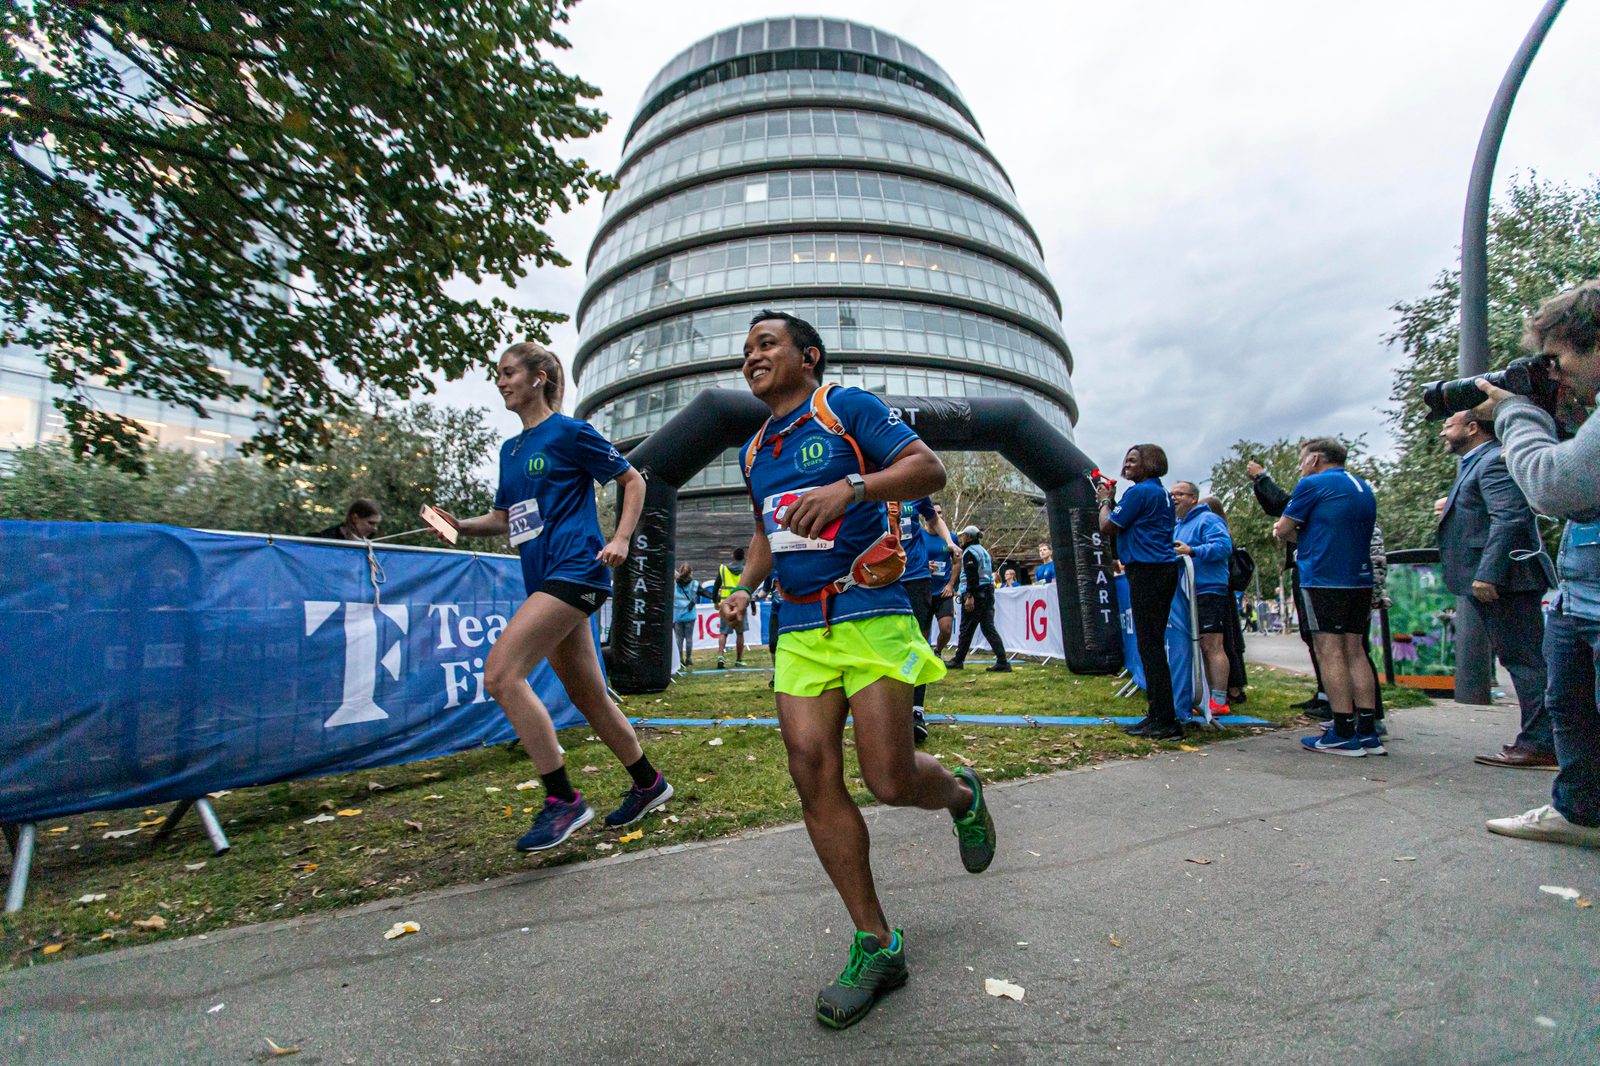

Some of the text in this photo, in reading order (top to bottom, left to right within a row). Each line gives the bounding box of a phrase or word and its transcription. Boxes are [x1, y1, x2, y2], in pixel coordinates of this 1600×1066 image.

[528, 457, 545, 472] 10
[801, 442, 824, 463] 10
[633, 534, 648, 636] START
[1091, 532, 1112, 624] START
[428, 604, 508, 649] Tea
[1025, 599, 1048, 642] IG
[440, 657, 496, 710] Fi
